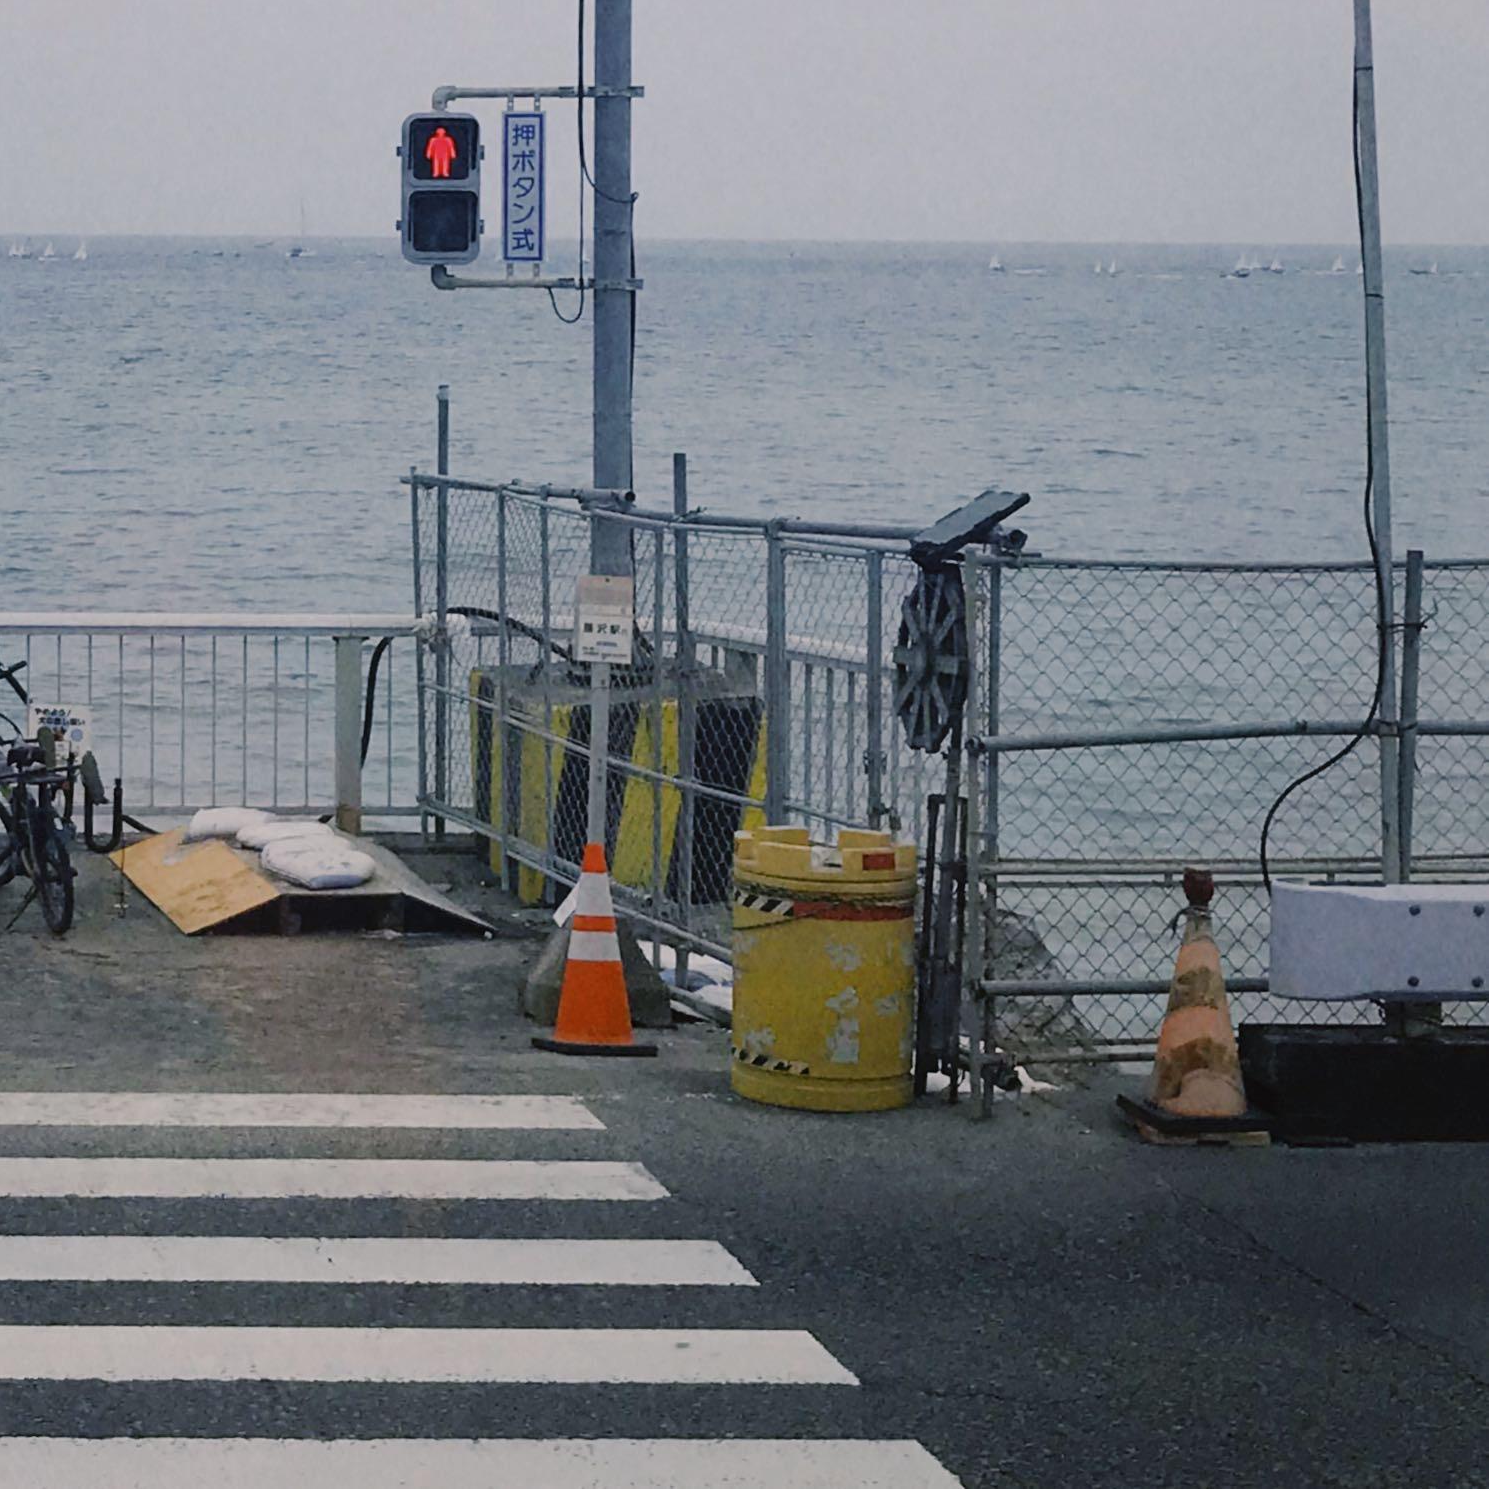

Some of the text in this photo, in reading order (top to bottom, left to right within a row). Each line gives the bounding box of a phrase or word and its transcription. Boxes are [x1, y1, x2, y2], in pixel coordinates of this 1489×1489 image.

[512, 124, 536, 252] 押ボタン式
